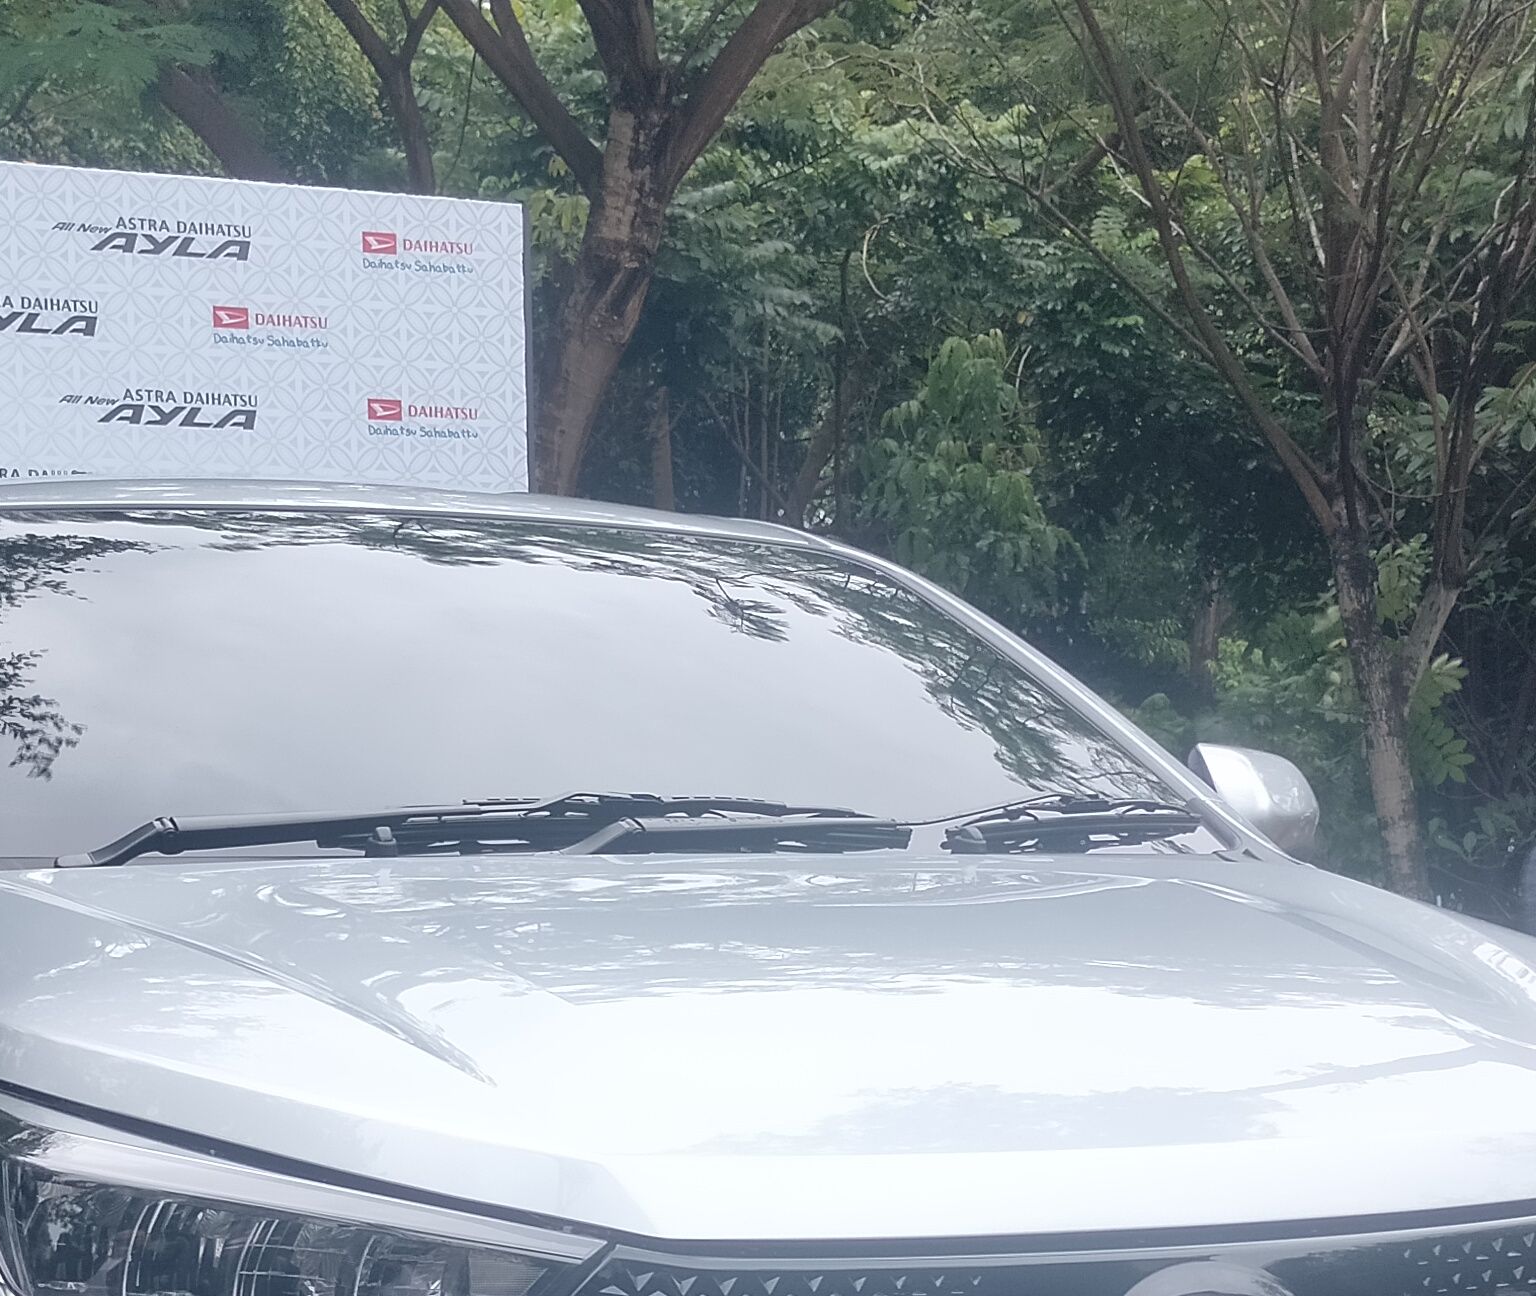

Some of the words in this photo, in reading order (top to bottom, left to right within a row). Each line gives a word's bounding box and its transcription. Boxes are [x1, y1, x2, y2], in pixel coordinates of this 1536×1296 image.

[51, 221, 75, 231] All
[76, 223, 113, 234] New
[115, 216, 170, 233] ASTRA
[176, 220, 252, 238] DAIHATSU
[89, 232, 251, 261] AYLA
[403, 238, 473, 255] DAIHATSU
[362, 257, 412, 270] Daihatsu
[20, 296, 99, 314] DAIHATSU
[255, 313, 328, 329] DAIHATSU
[213, 332, 264, 345] Daihatsu
[59, 394, 82, 404] All
[84, 396, 120, 406] New
[122, 388, 177, 403] ASTRA
[183, 391, 258, 407] DAIHATSU
[97, 403, 257, 430] AYLA
[408, 405, 478, 420] DAIHATSU
[368, 424, 417, 436] Daihatsu
